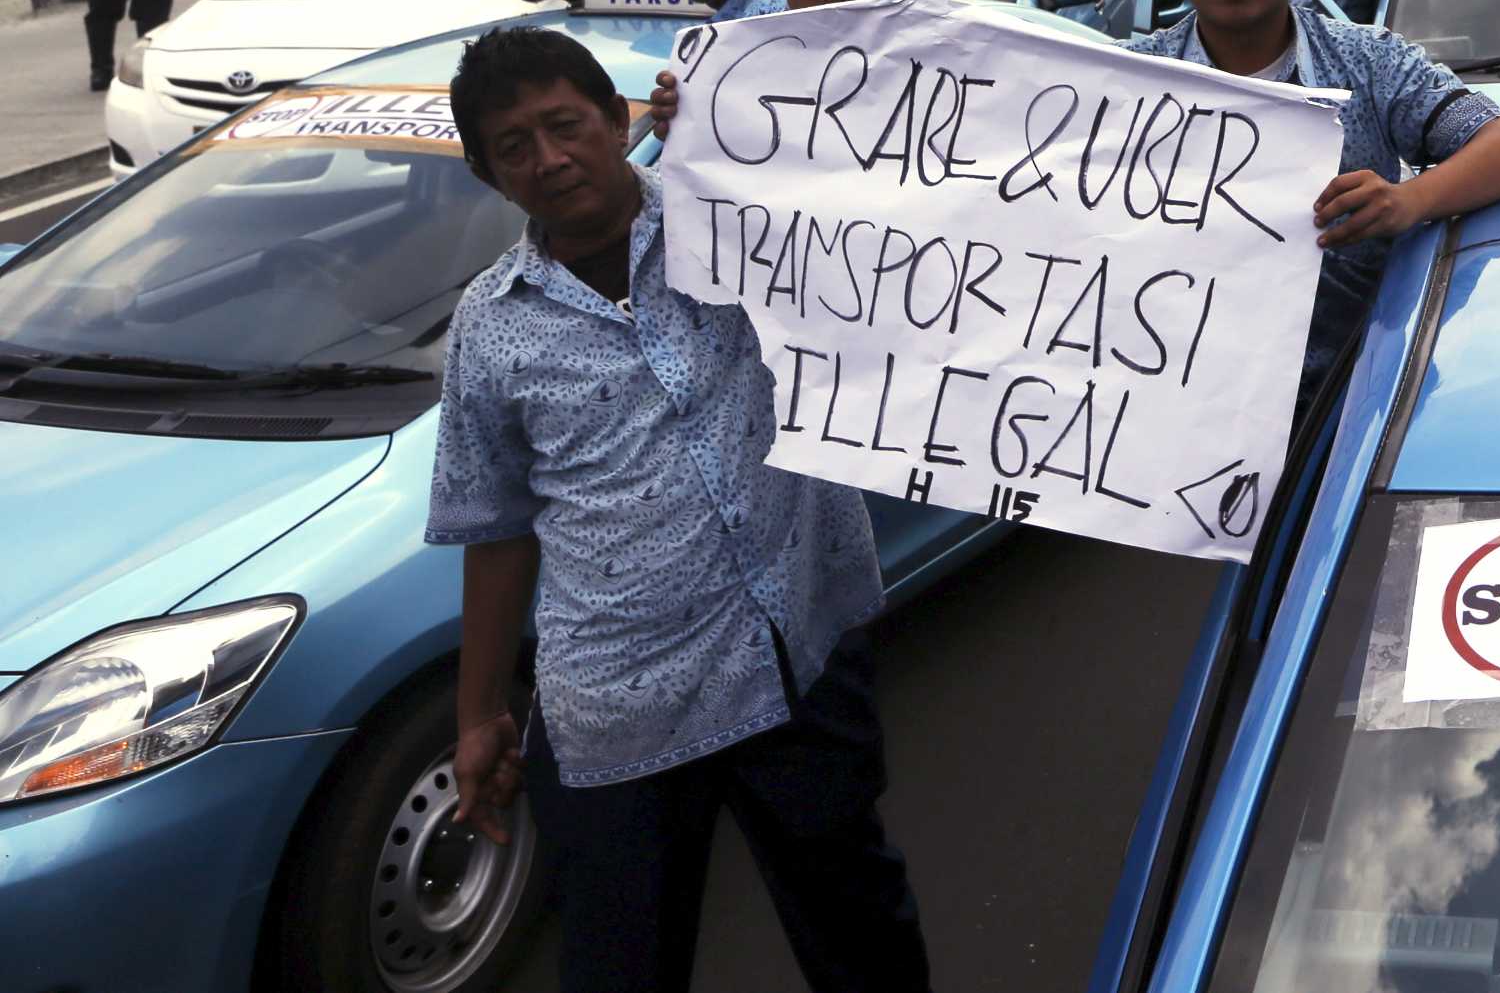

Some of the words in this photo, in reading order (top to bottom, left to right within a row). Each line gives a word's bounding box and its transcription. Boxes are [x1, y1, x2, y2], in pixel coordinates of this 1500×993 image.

[246, 108, 308, 124] STOP
[321, 94, 451, 115] ILLE
[711, 34, 998, 187] GRABE
[298, 120, 460, 140] TRANSPOR
[779, 343, 1150, 509] ILLEGAL
[904, 467, 934, 504] H
